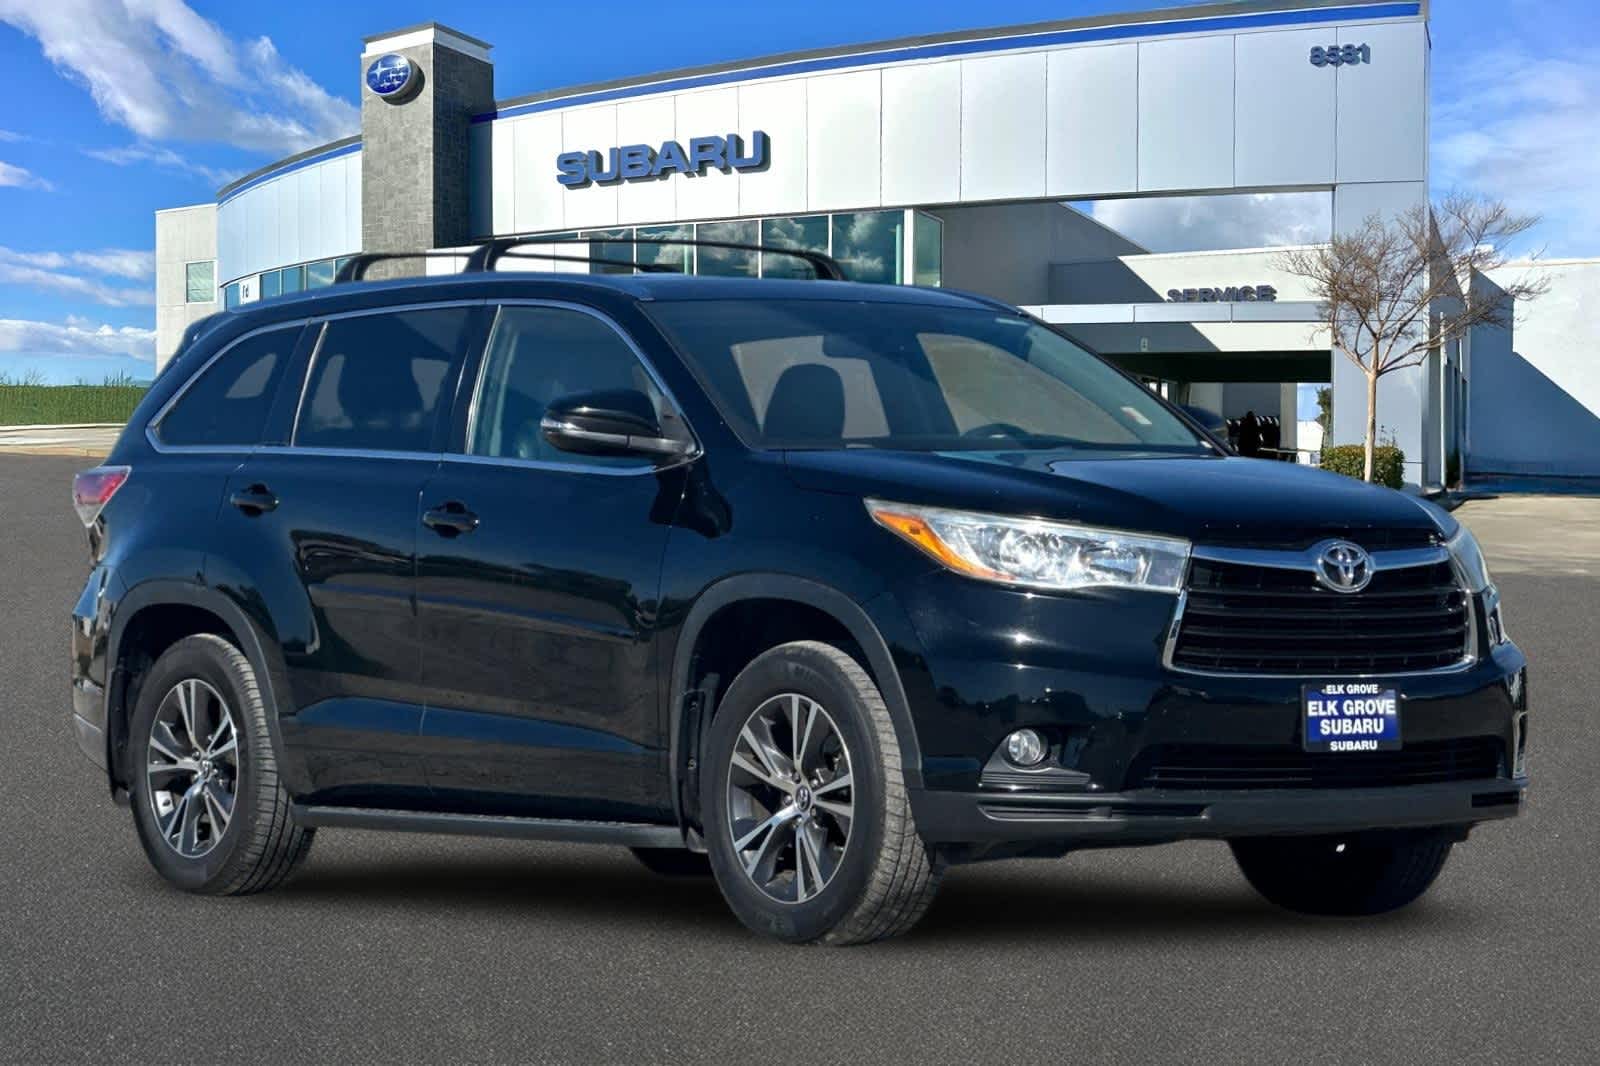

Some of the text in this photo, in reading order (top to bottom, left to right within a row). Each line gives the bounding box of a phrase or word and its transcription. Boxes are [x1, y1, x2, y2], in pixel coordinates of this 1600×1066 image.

[556, 130, 771, 190] SUBARU
[1165, 284, 1277, 302] SERVICE
[1326, 684, 1378, 694] ELK GROVE
[1307, 699, 1396, 717] ELK GROVE
[1320, 718, 1384, 735] SUBARU
[1330, 740, 1378, 751] SUBARU
